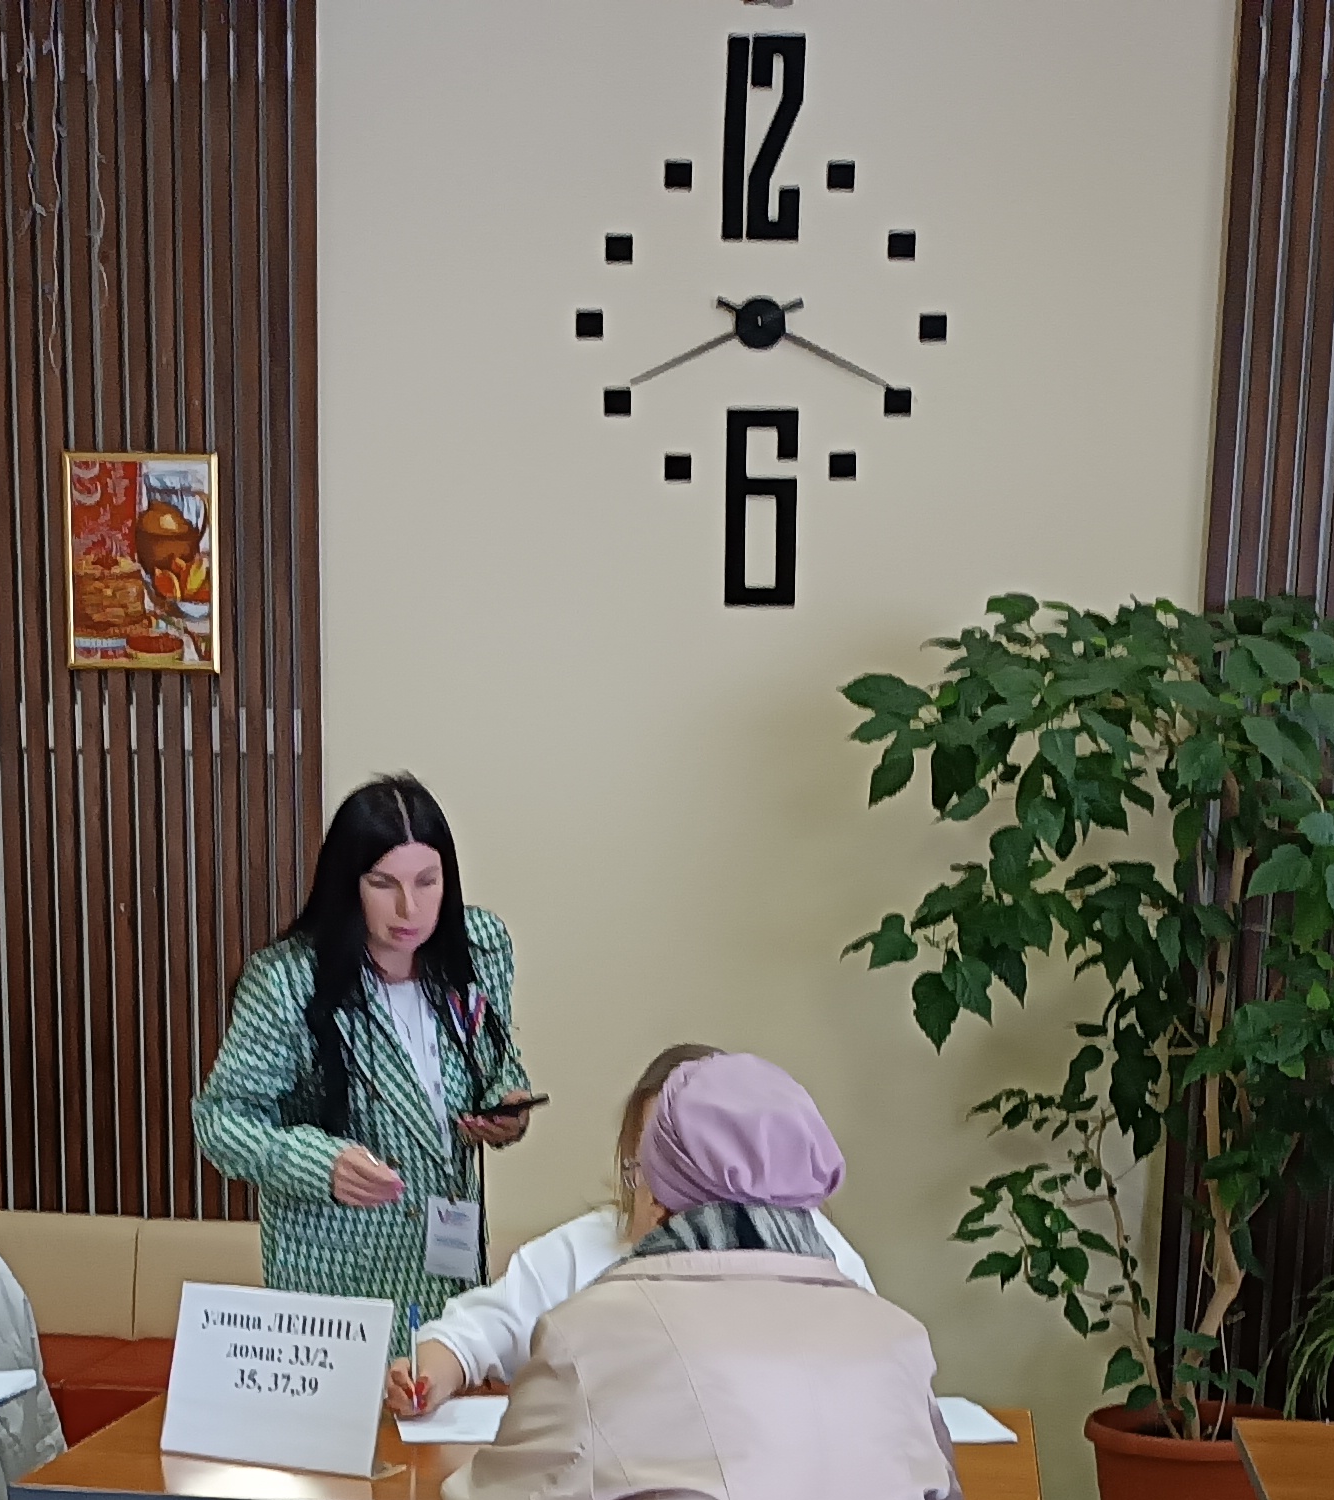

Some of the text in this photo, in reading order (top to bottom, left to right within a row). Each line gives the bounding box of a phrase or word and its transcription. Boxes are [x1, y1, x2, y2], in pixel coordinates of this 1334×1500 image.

[721, 33, 806, 241] 12
[724, 407, 798, 607] 6
[201, 1308, 368, 1343] улица ЛЕНИНА
[226, 1342, 334, 1370] дома: 33/2,
[234, 1368, 263, 1393] 35,
